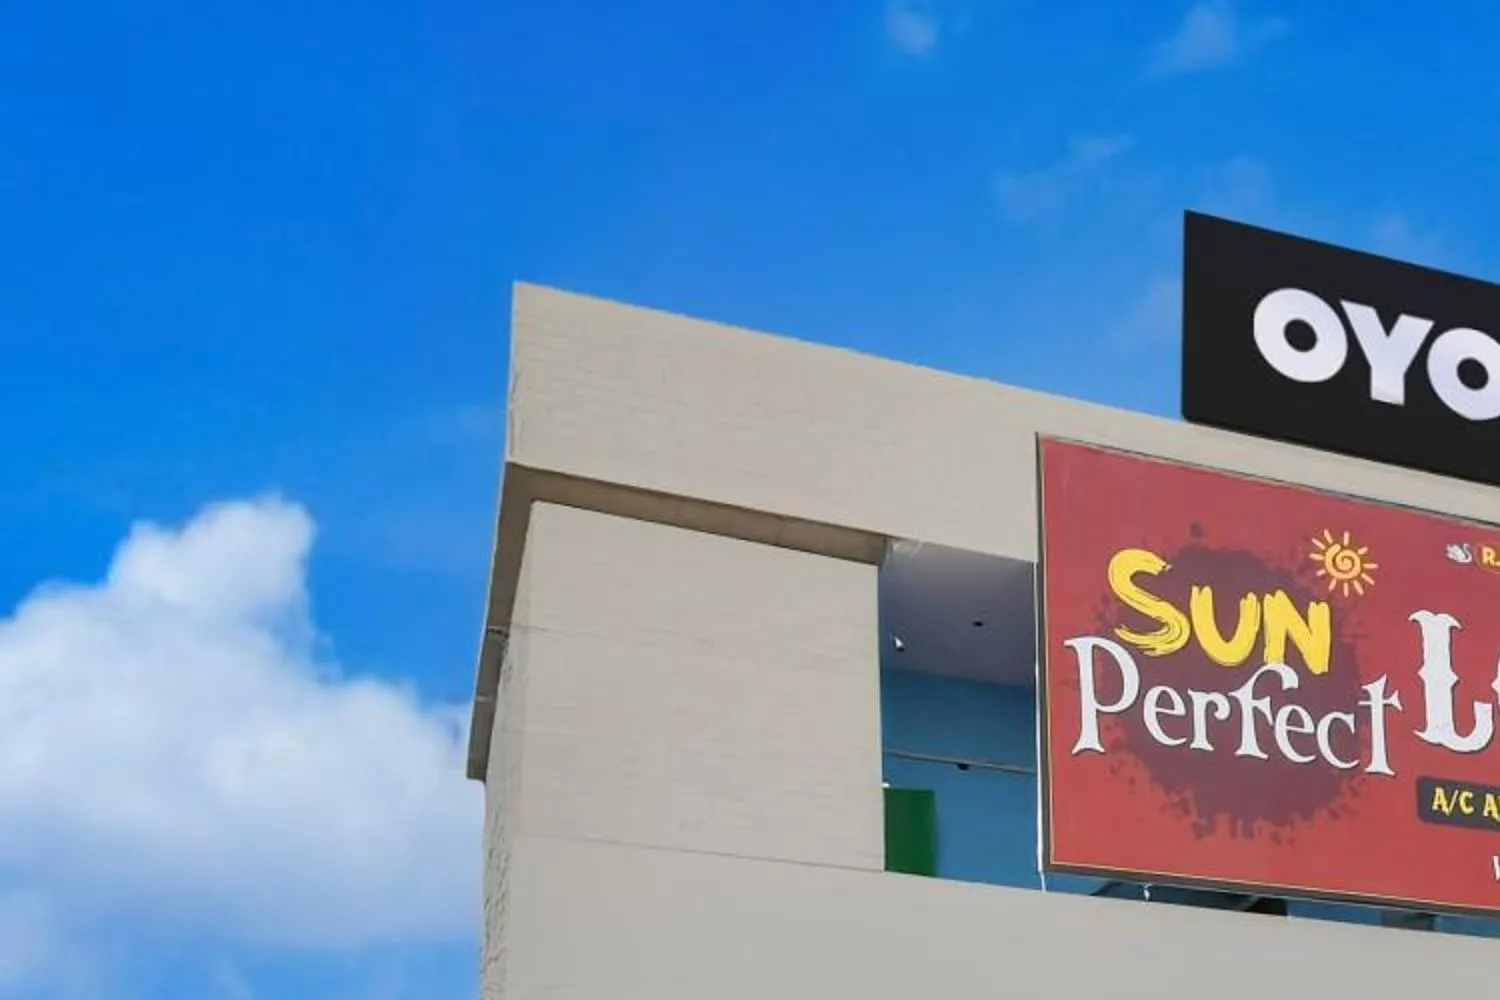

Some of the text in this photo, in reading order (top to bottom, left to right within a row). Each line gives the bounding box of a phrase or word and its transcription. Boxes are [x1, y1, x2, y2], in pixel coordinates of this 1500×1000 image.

[1108, 548, 1331, 675] SUN
[1064, 636, 1402, 776] Perfect
[1432, 786, 1475, 816] A/C
